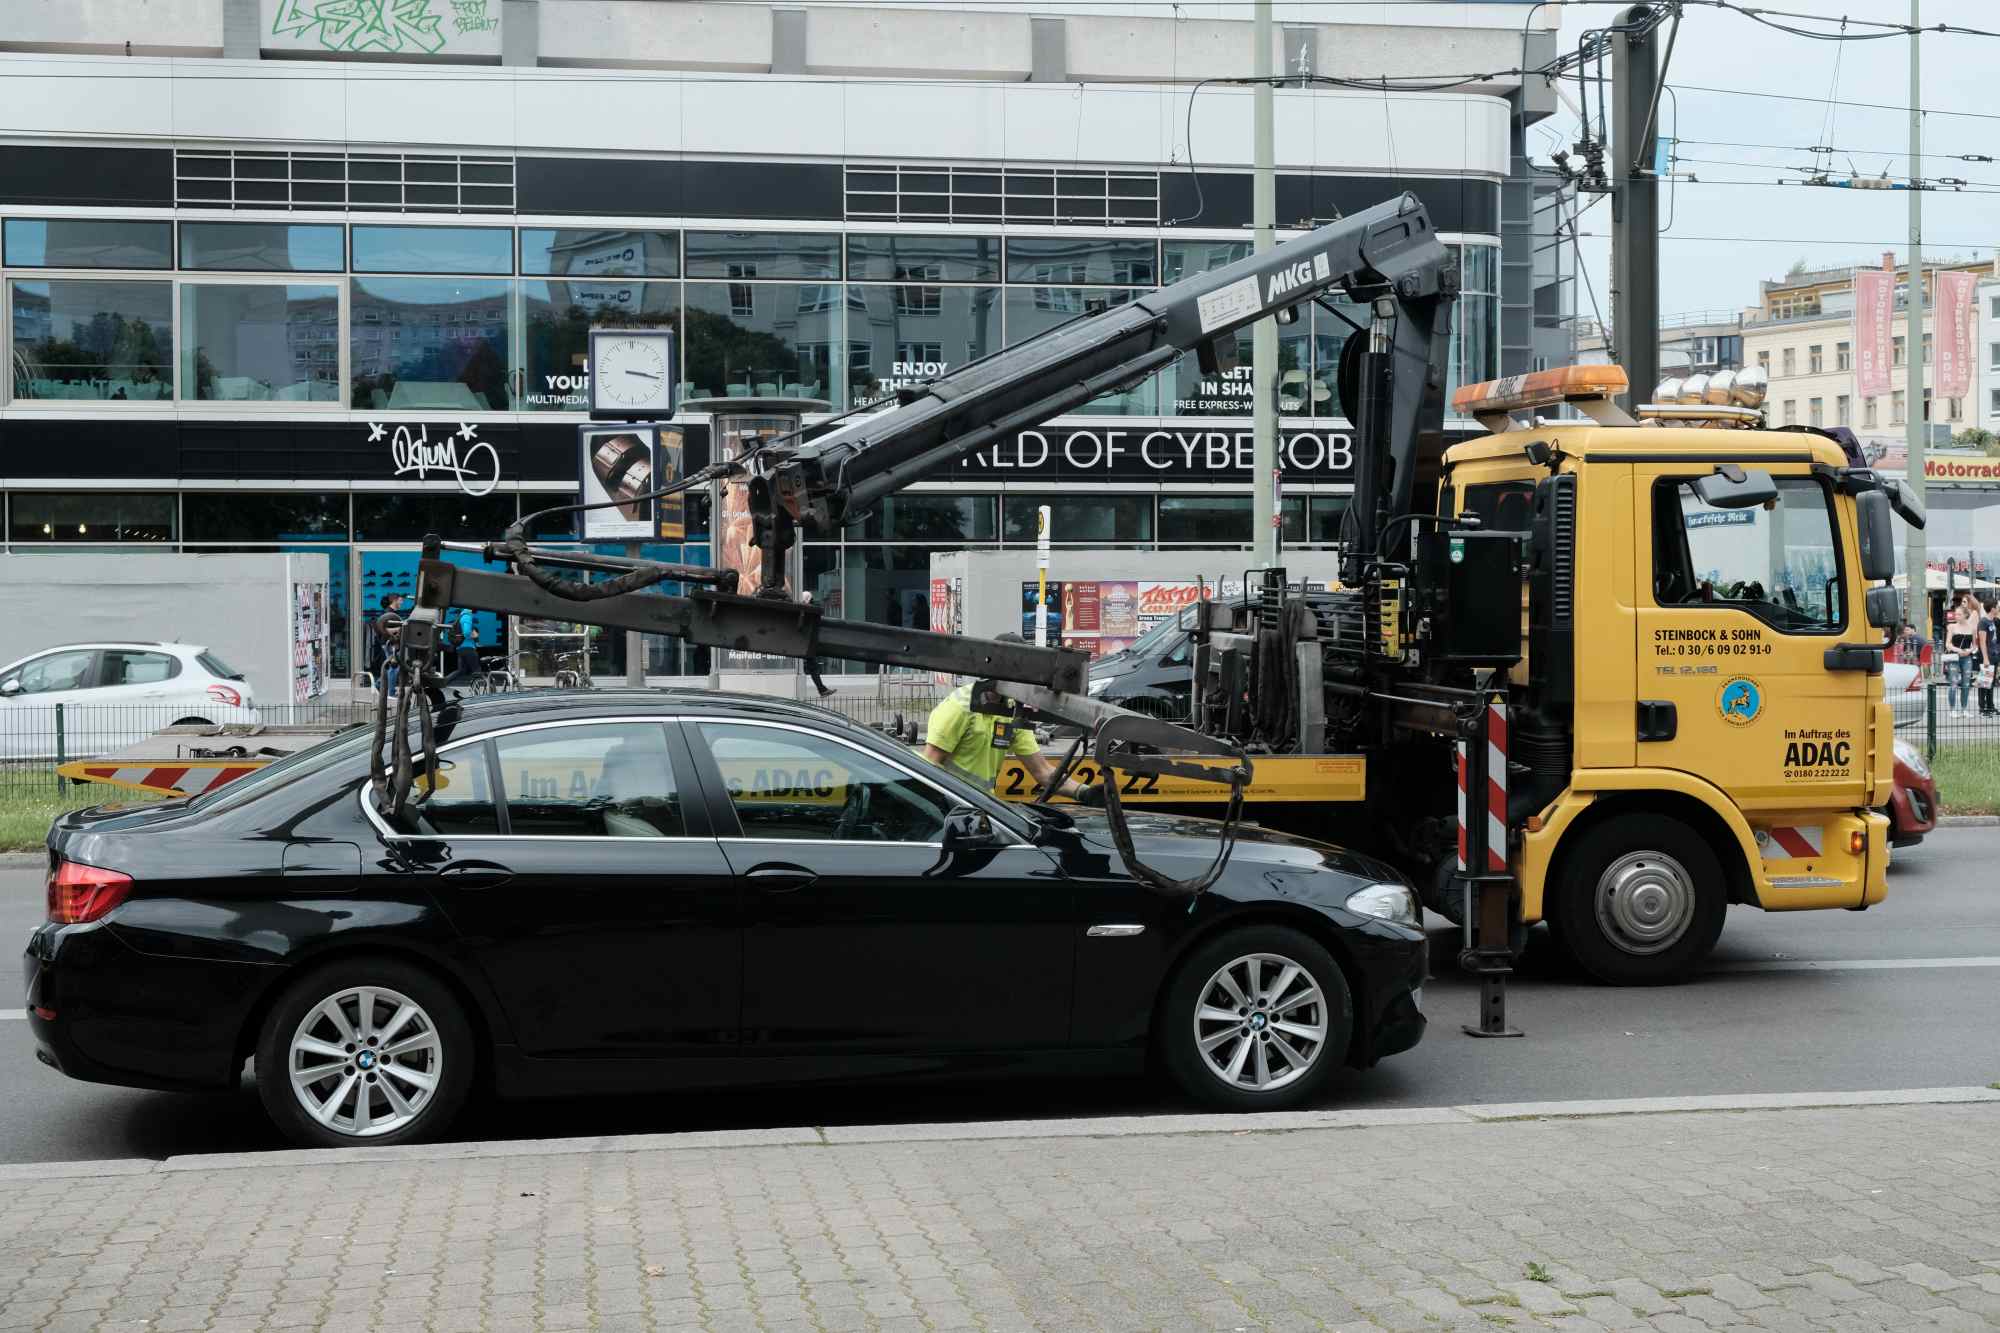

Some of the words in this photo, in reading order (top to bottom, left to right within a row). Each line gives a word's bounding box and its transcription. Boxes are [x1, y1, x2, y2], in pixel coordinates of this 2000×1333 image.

[1268, 261, 1312, 302] MKG
[892, 361, 948, 376] ENJOY
[1221, 366, 1253, 379] GET
[1201, 382, 1218, 395] IN
[1221, 382, 1254, 396] SHA
[1174, 400, 1196, 409] FREE
[1064, 430, 1127, 468] OF
[1654, 629, 1716, 641] STEINBOCK
[1720, 630, 1728, 640] &
[1732, 629, 1761, 640] SOHN
[1655, 645, 1675, 656] Tel.:
[1678, 645, 1685, 655] 0
[1688, 644, 1714, 656] 30/6
[1717, 644, 1731, 655] 09
[1733, 644, 1746, 655] 02
[1750, 644, 1772, 655] 91-0
[1784, 730, 1797, 739] Im
[1799, 729, 1833, 740] Auftrag
[1835, 729, 1850, 738] des
[1784, 741, 1850, 767] ADAC
[1794, 769, 1813, 778] 0180
[1814, 769, 1819, 777] 2
[1820, 769, 1830, 777] 22
[1830, 769, 1840, 777] 22
[1841, 768, 1850, 777] 22
[520, 769, 557, 799] Im
[752, 769, 833, 797] ADAC
[1005, 767, 1026, 795] 2
